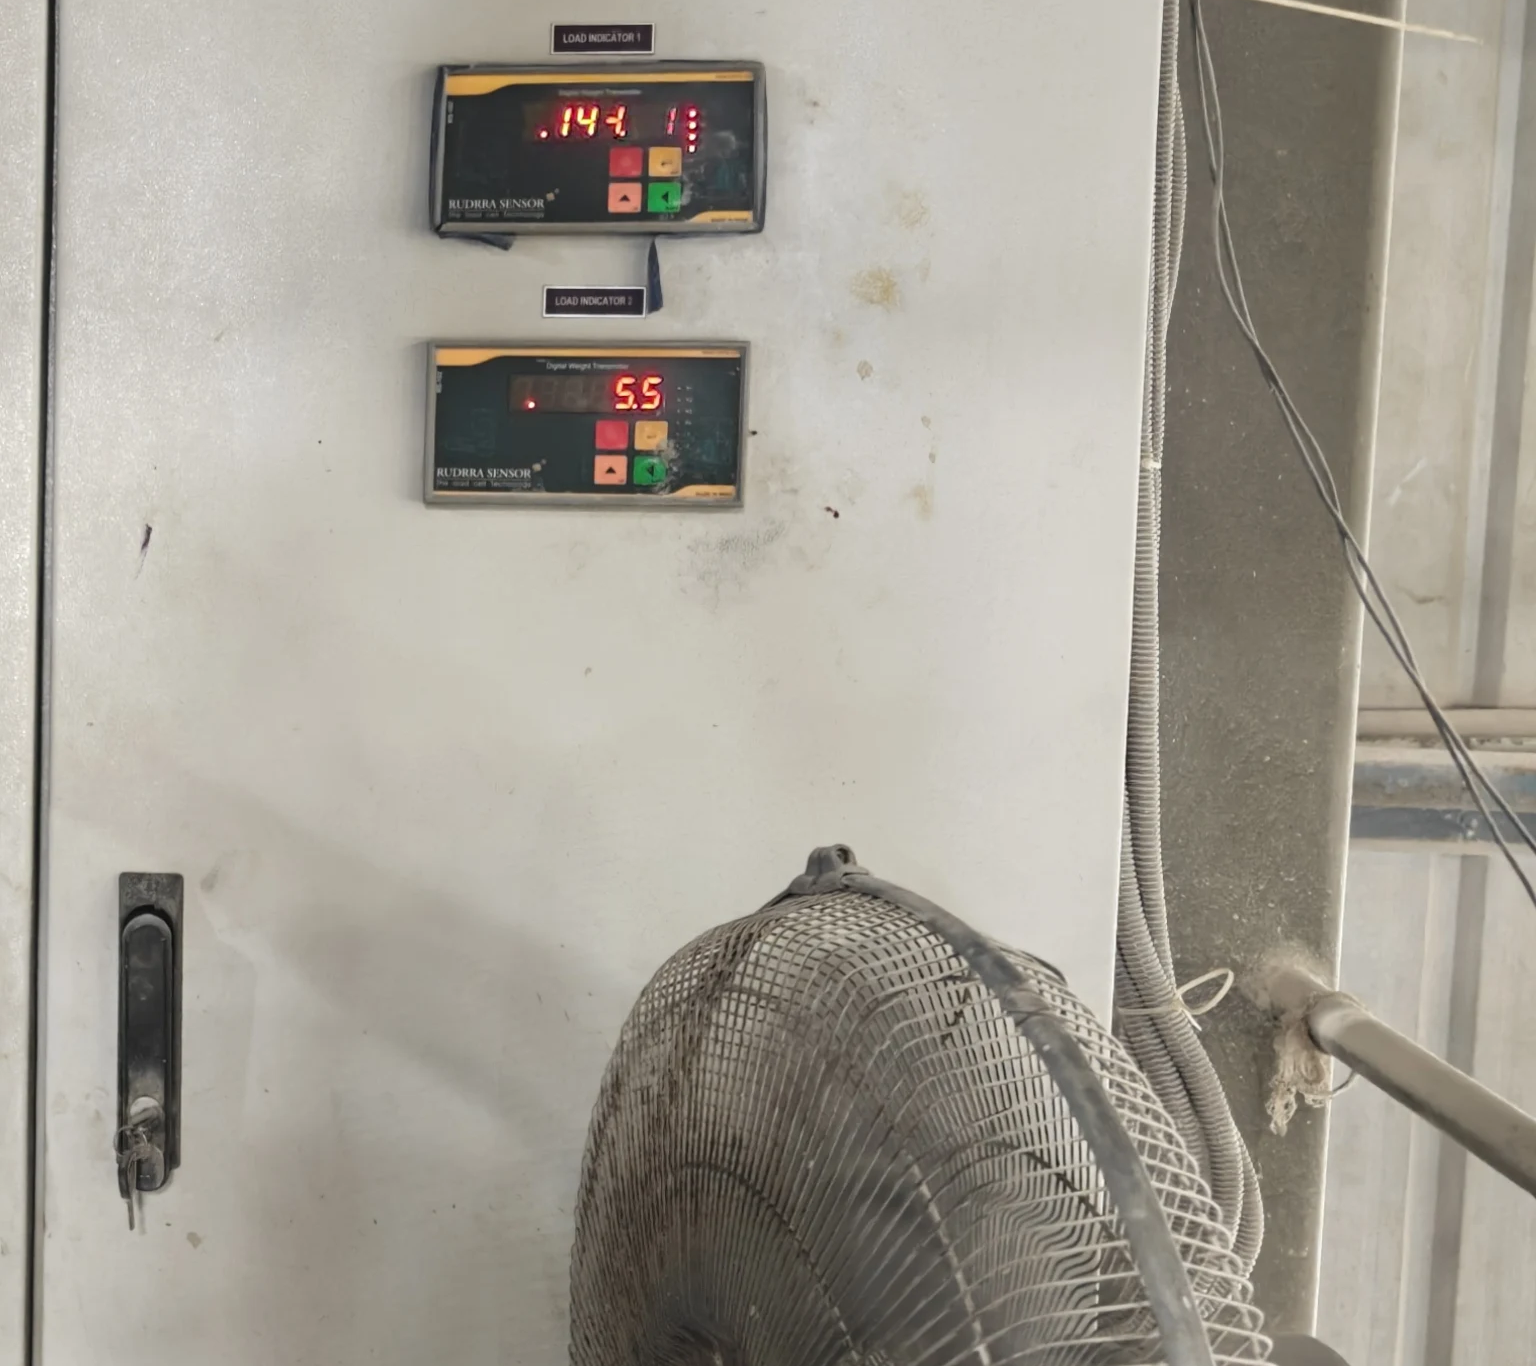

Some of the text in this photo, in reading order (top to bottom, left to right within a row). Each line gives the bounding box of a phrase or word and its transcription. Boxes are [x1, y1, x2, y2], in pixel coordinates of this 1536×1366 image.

[562, 33, 587, 43] LOAD
[588, 32, 634, 43] INDICATOR
[448, 198, 545, 209] RUDRRA SENSOR
[555, 296, 578, 306] LOAD
[580, 296, 626, 306] INDICATOR
[614, 375, 664, 411] 5.5
[436, 467, 531, 478] RUDRRA SENSOR
